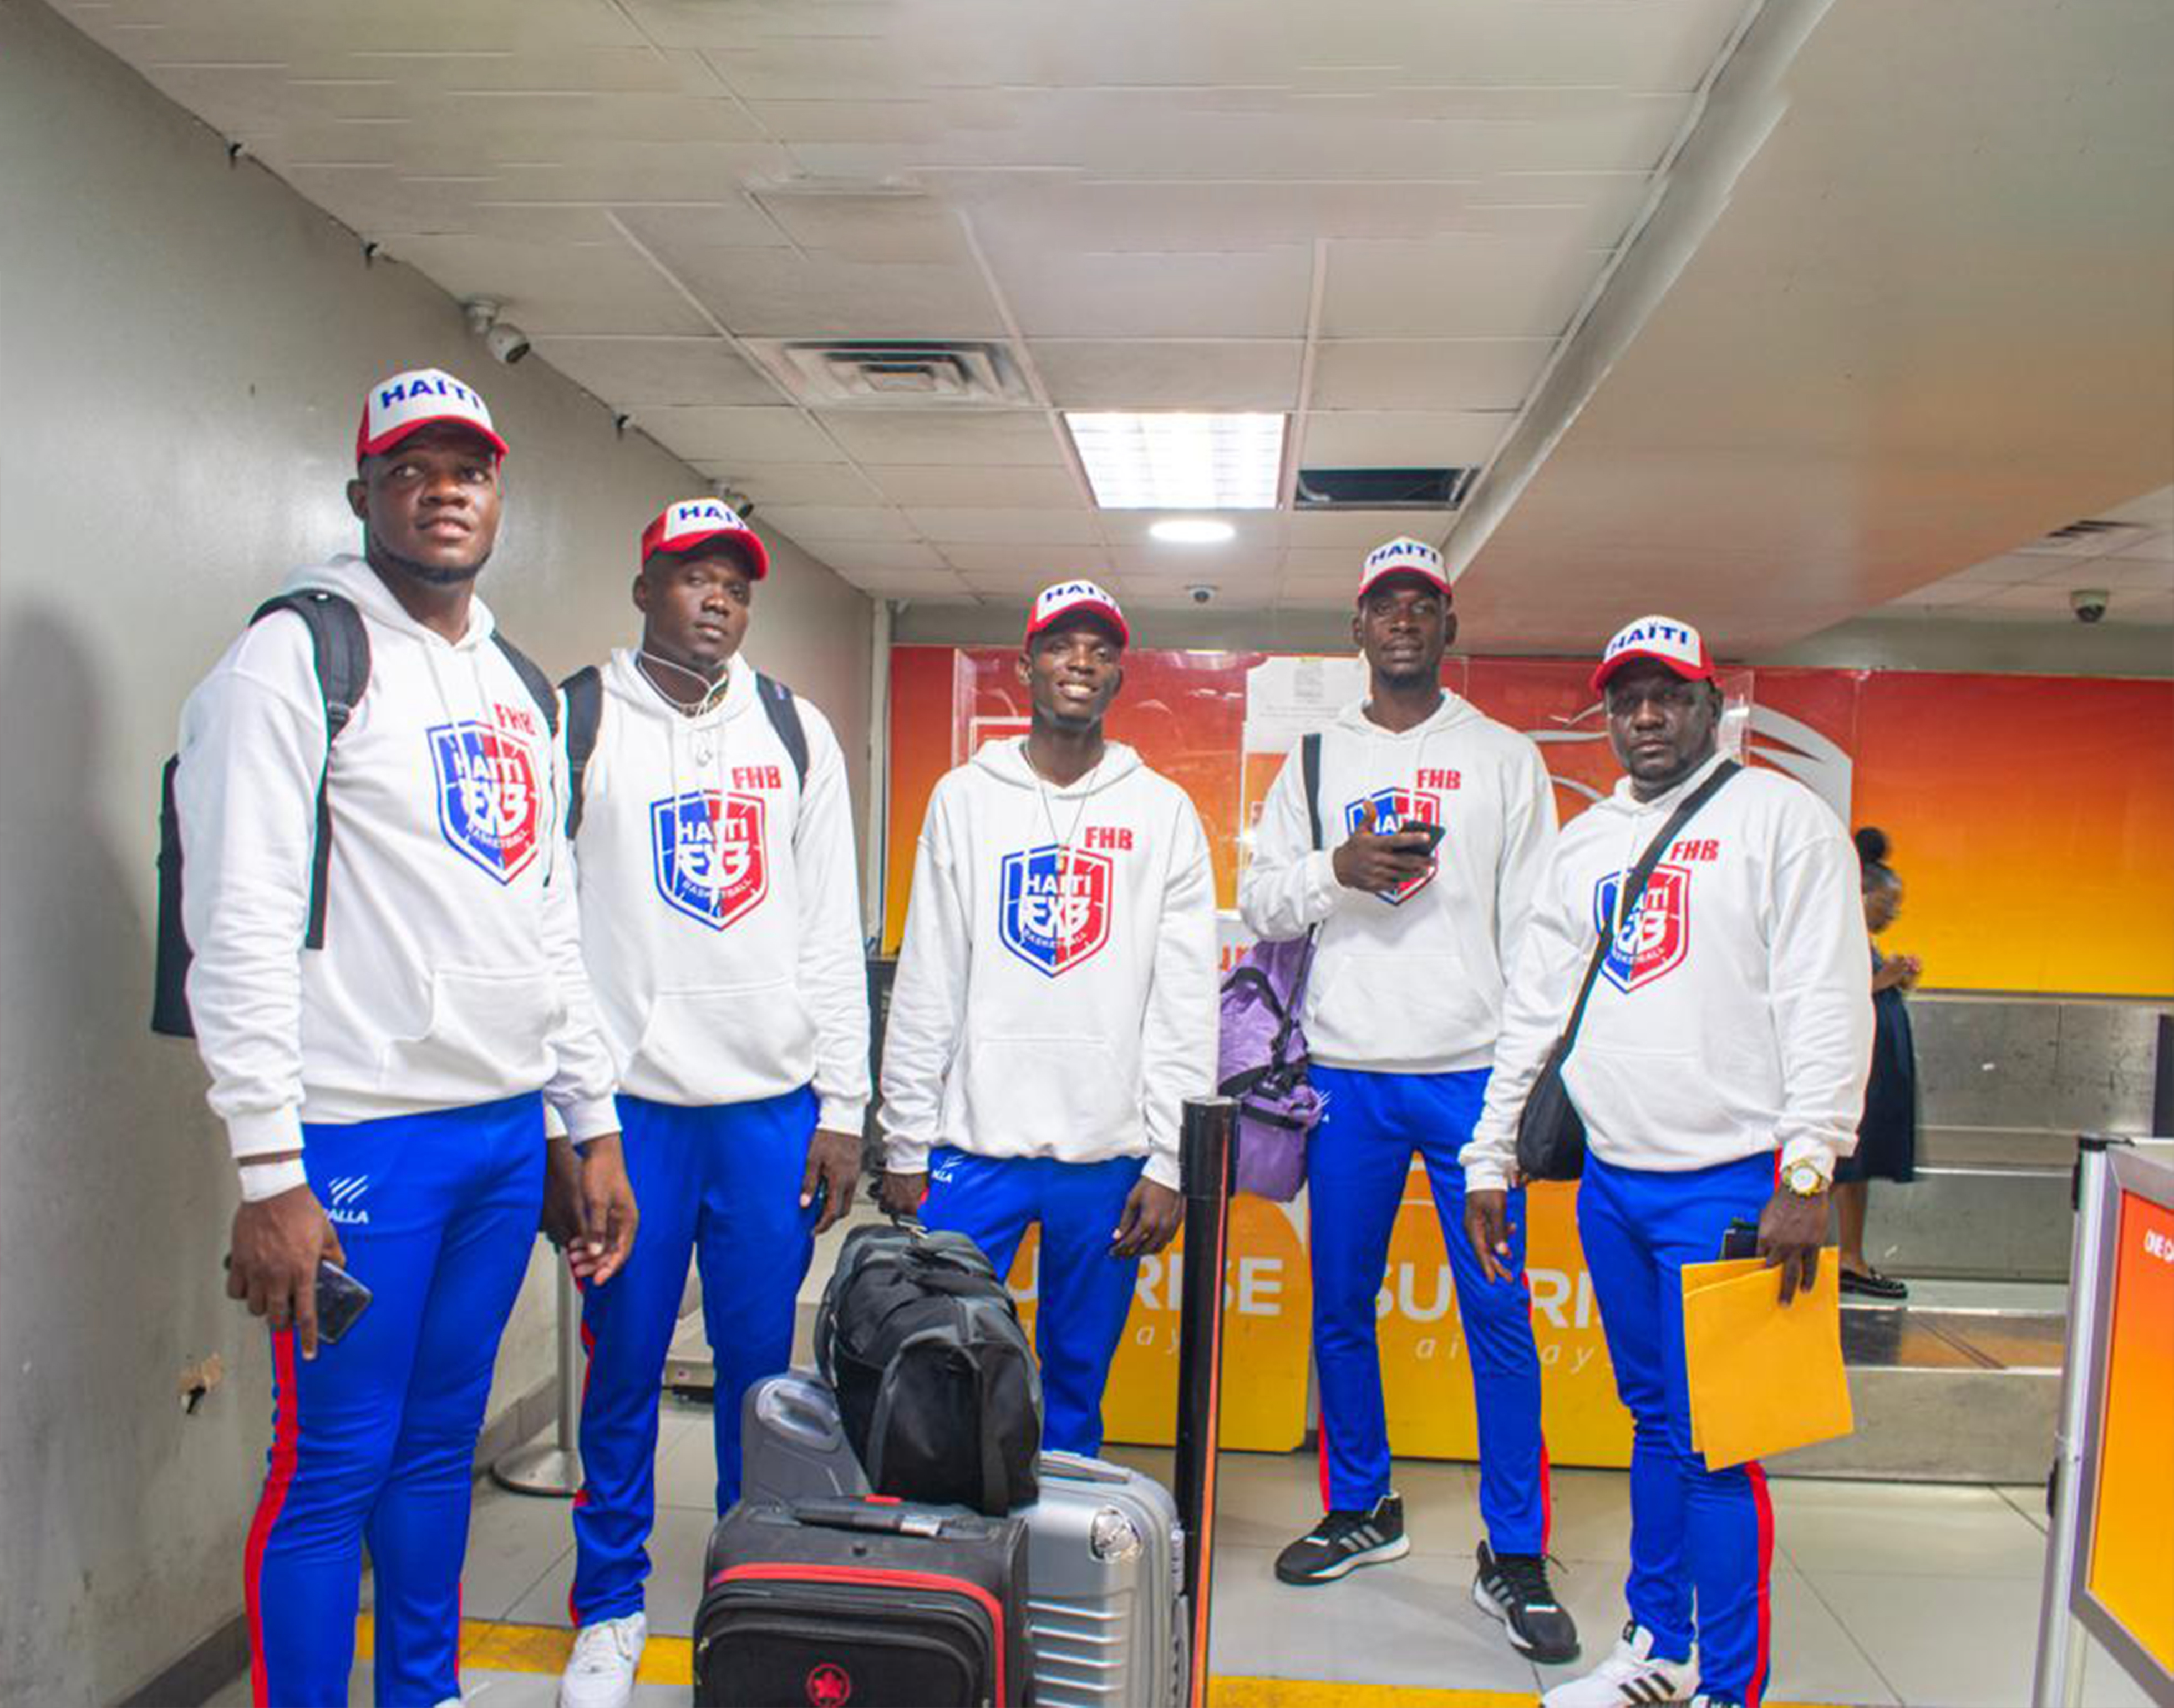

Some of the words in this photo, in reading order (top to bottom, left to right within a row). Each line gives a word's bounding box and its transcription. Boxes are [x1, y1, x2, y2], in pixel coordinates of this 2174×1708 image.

[732, 766, 782, 789] FHB
[1417, 767, 1461, 790] FHB
[1085, 826, 1132, 850] FHB
[1670, 840, 1719, 861] FHB
[1024, 873, 1091, 897] HAITI
